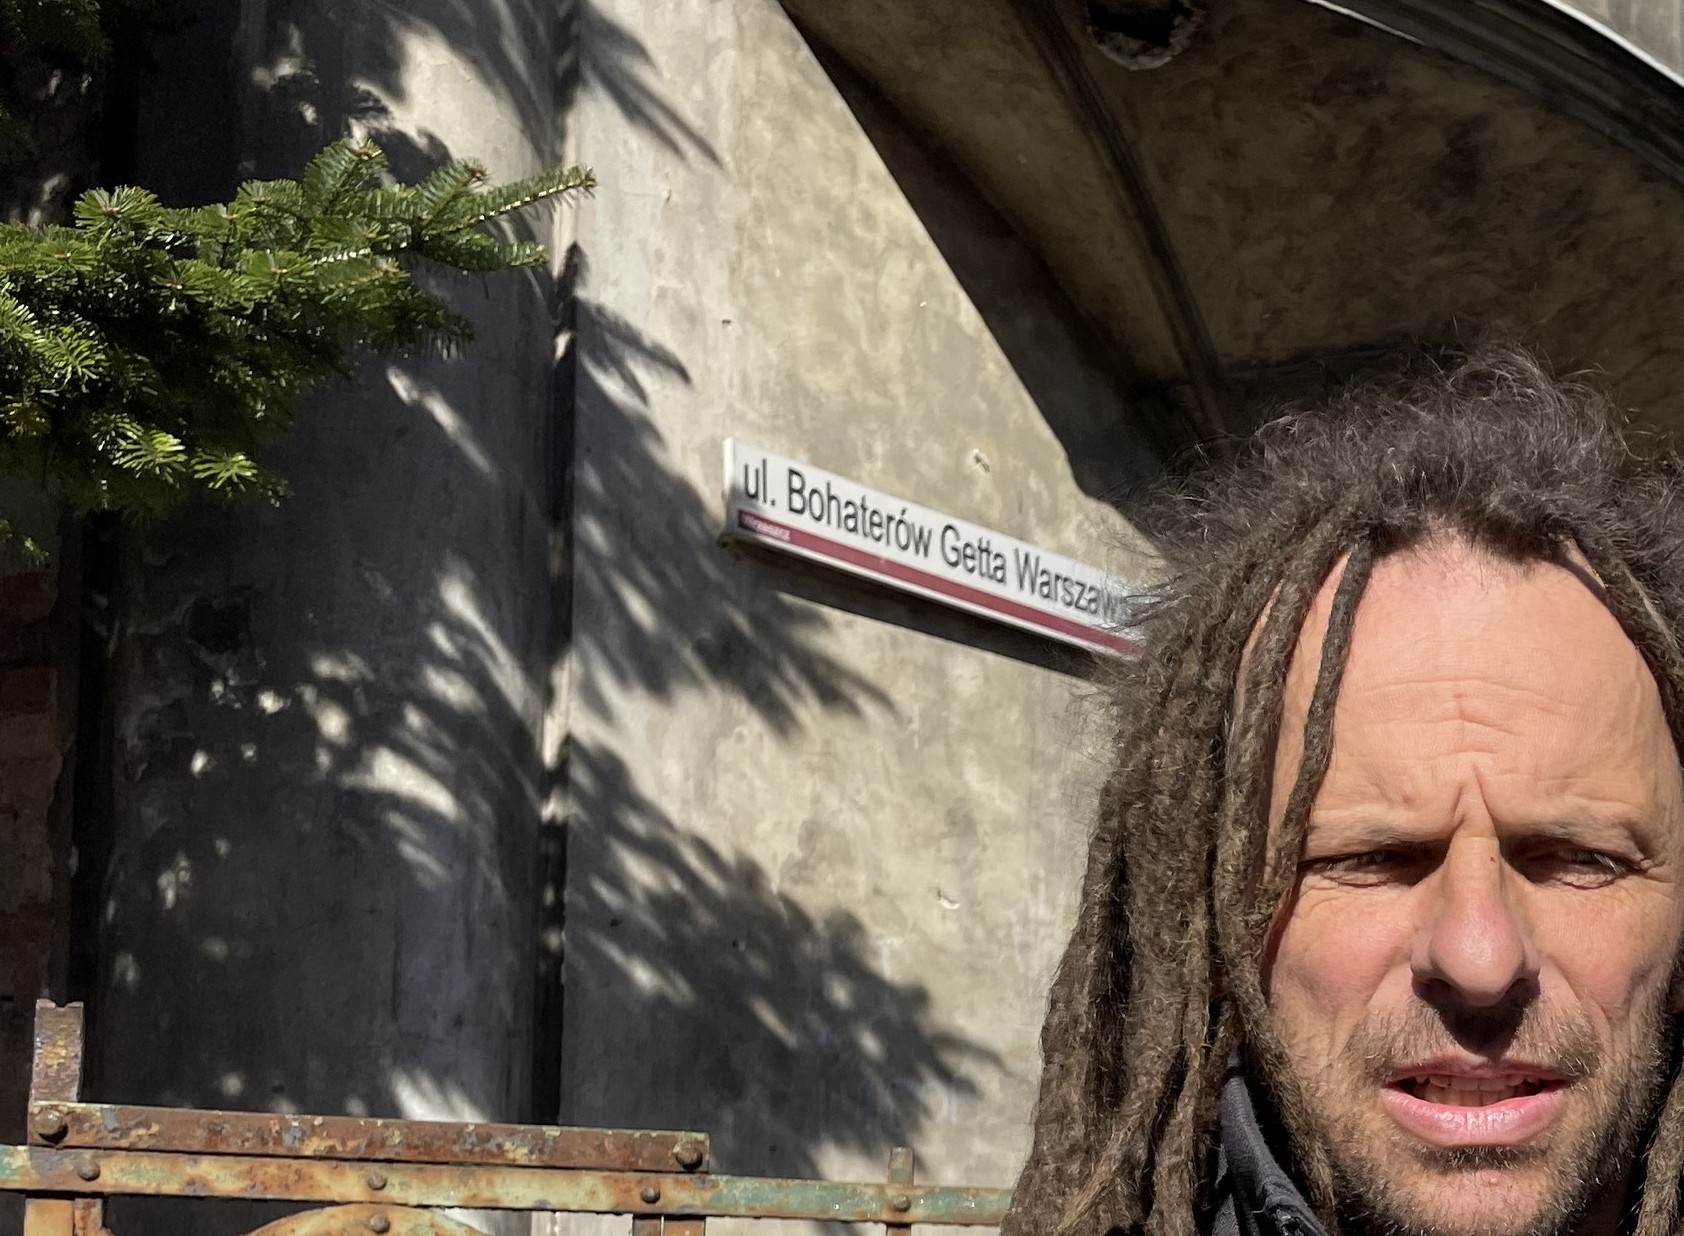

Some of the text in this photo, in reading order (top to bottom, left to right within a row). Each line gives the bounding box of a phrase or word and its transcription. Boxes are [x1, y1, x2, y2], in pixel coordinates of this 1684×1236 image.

[744, 458, 776, 507] ul.
[788, 467, 933, 559] Bohaterów
[940, 524, 1007, 584] Getta
